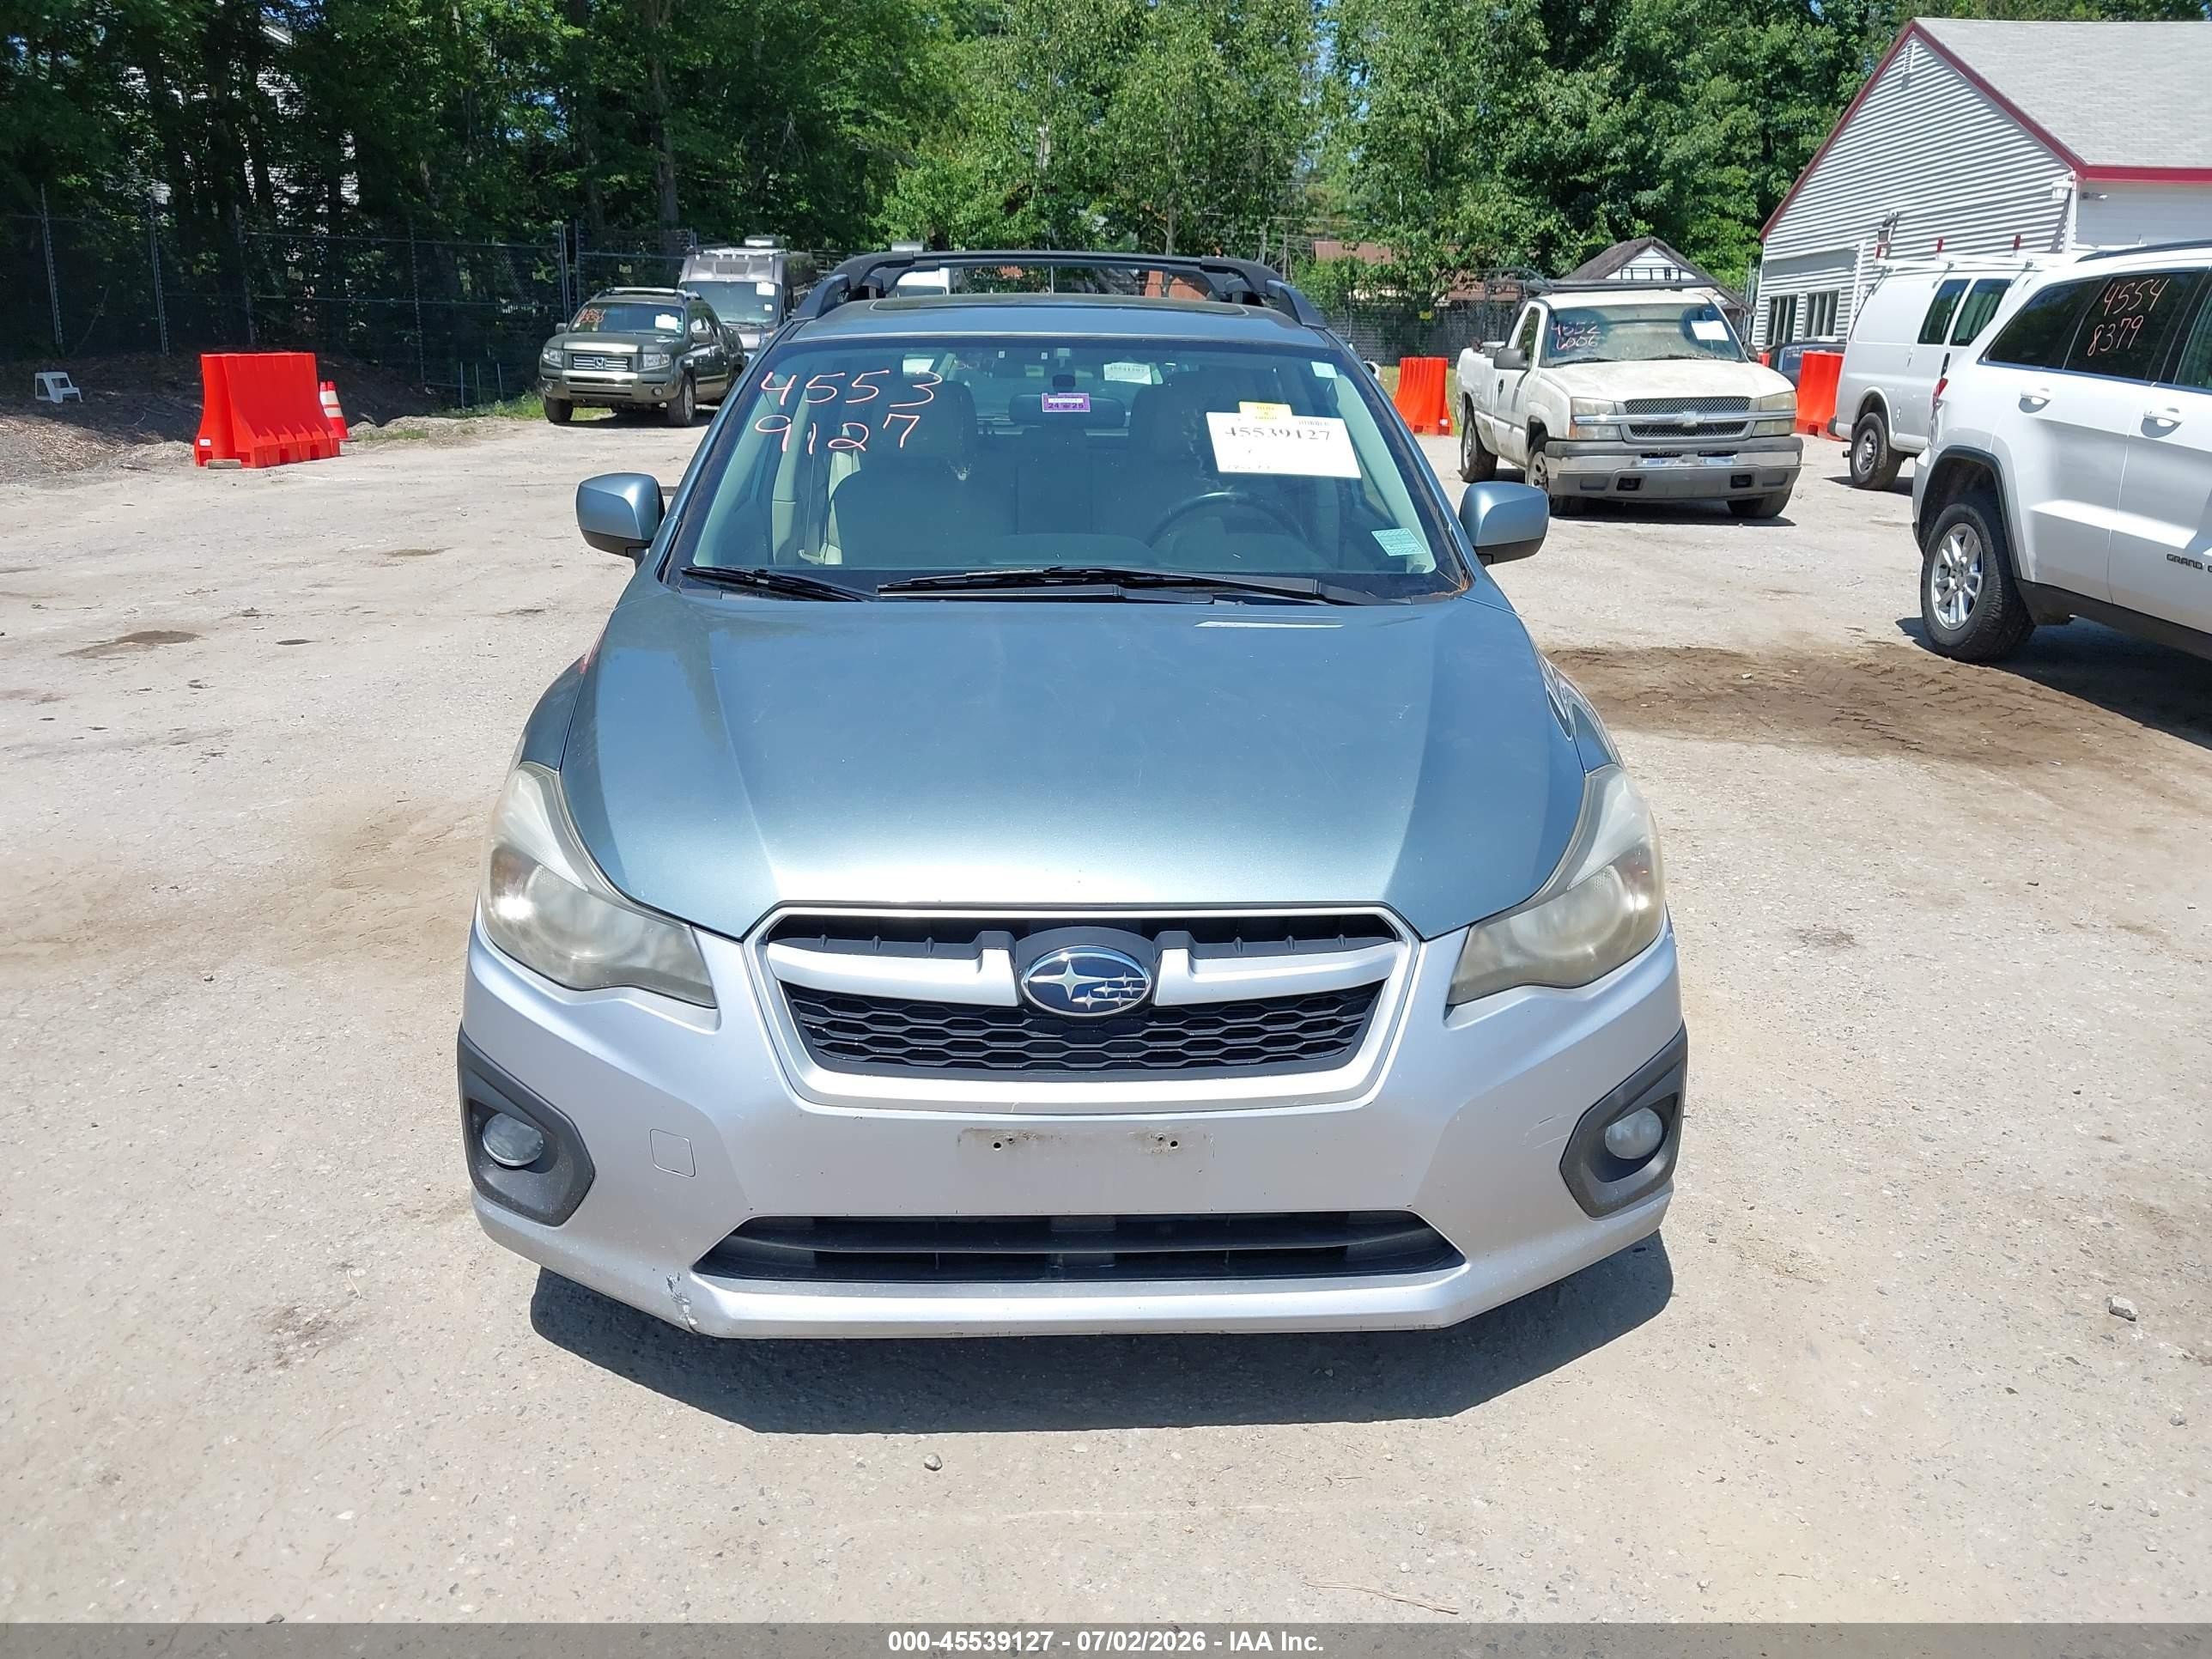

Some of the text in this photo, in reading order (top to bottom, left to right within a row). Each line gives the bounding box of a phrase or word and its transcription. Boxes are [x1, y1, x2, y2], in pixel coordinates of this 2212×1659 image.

[2104, 278, 2171, 317] 4554
[2087, 314, 2144, 357] 8379
[760, 369, 944, 408] 4553
[754, 413, 921, 455] 9127
[1224, 426, 1330, 441] 45539127
[2166, 553, 2203, 570] GRAND
